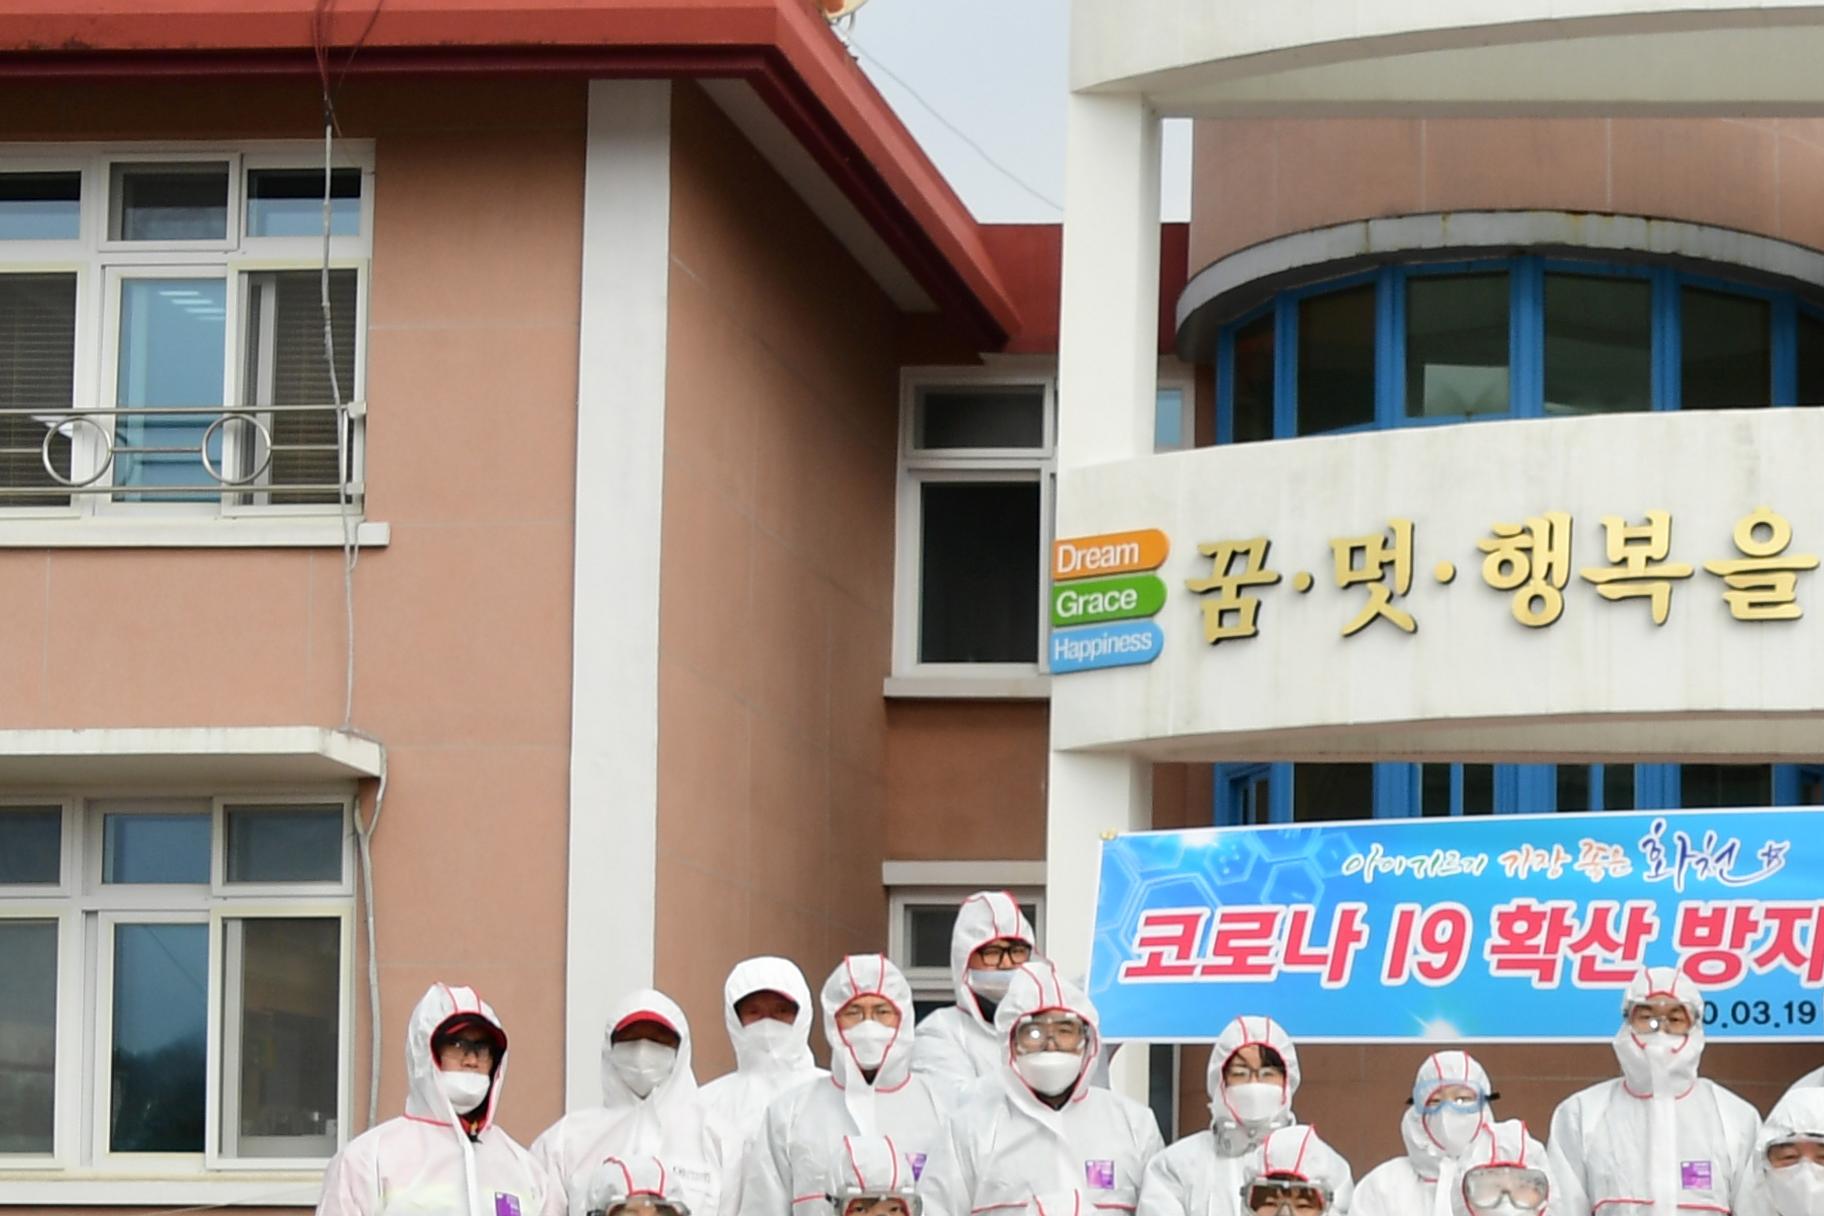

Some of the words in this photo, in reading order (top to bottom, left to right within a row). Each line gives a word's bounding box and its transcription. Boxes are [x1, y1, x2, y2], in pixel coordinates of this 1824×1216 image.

[1057, 542, 1140, 573] Dream
[1056, 588, 1138, 618] Grace
[1053, 632, 1153, 663] Happiness
[1640, 819, 1768, 890] 화천
[1121, 904, 1366, 984] 코로나
[1381, 902, 1470, 982] 19
[1490, 901, 1653, 982] 확산
[1702, 1000, 1817, 1029] 0.03.19
